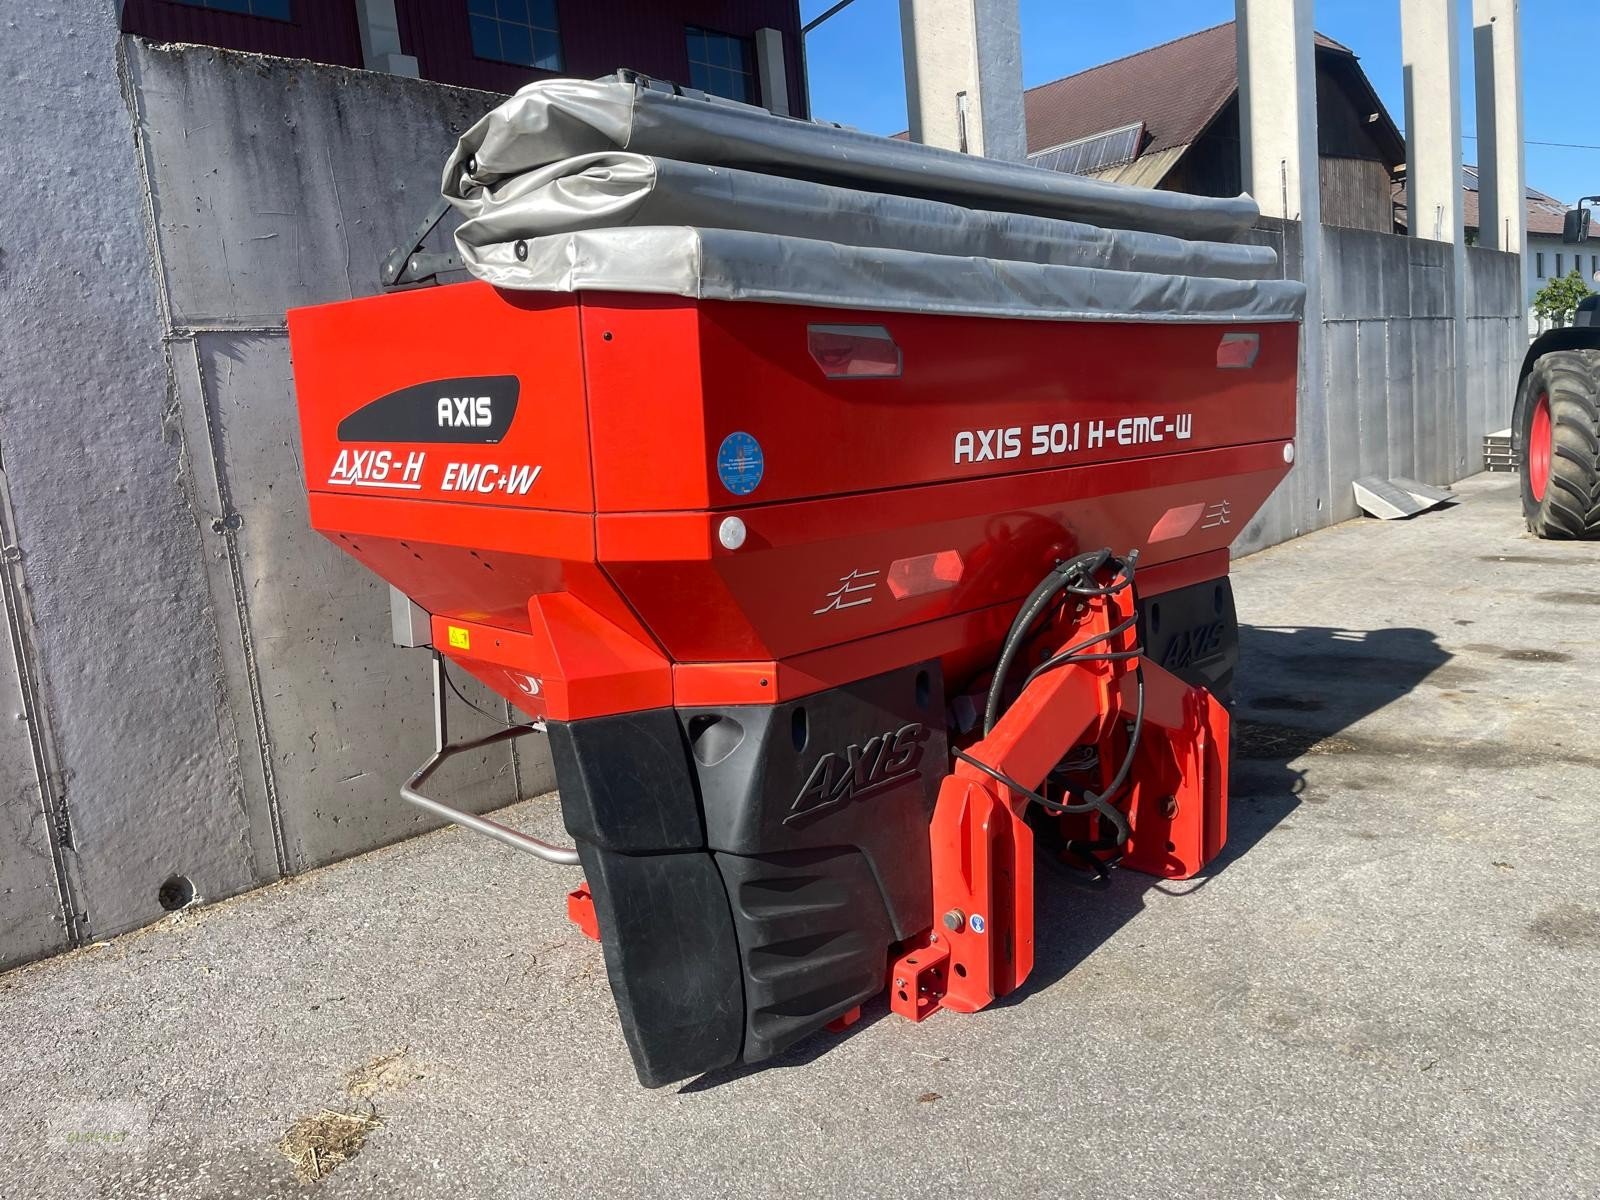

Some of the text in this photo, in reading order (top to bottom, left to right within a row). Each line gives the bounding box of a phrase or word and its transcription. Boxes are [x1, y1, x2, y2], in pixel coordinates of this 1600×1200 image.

[437, 397, 492, 427] AXIS
[953, 413, 1192, 464] AXIS 50.1 H-EMC-W
[329, 449, 542, 495] AXIS-H EMC+W
[789, 722, 925, 810] AXIS
